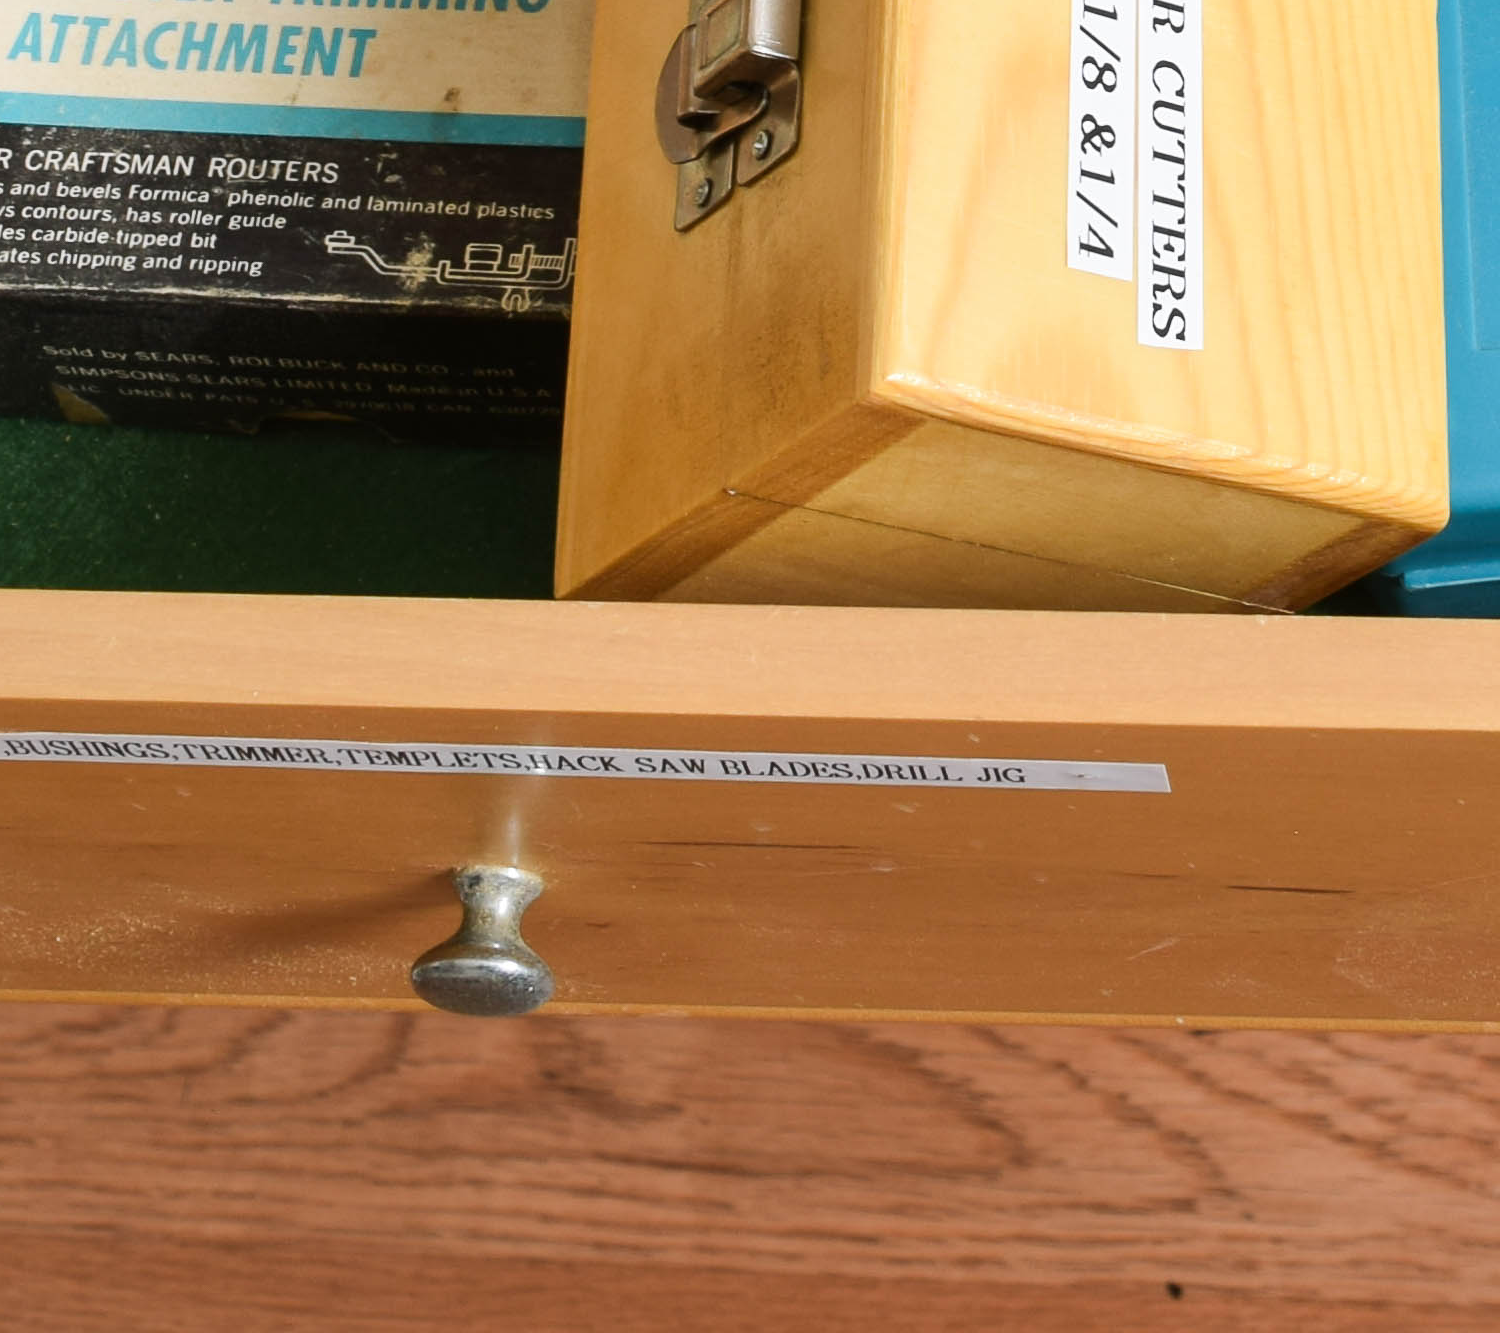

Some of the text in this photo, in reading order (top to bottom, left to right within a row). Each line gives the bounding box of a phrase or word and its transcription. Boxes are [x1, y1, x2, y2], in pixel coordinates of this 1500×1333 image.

[6, 12, 377, 78] ATTACHMENT
[24, 150, 194, 175] CRAFTSMAN
[208, 157, 340, 183] ROUTERS
[10, 181, 49, 197] and
[57, 182, 122, 200] bevels
[227, 191, 314, 209] phenolic
[322, 195, 360, 210] and
[368, 197, 469, 216] laminated
[477, 204, 555, 220] plastics
[1152, 60, 1187, 342] CUTTERS
[22, 205, 117, 224] contours,
[126, 207, 162, 224] has
[169, 210, 222, 226] roller
[228, 214, 287, 230] guide
[191, 233, 218, 249] bit
[47, 250, 136, 271] chipping
[143, 254, 182, 270] and
[189, 257, 263, 277] ripping
[43, 345, 93, 358] Sold
[102, 350, 127, 361] by
[634, 757, 707, 775] SAW
[720, 760, 963, 782] BLADES,DRILL
[976, 768, 1026, 784] JIG
